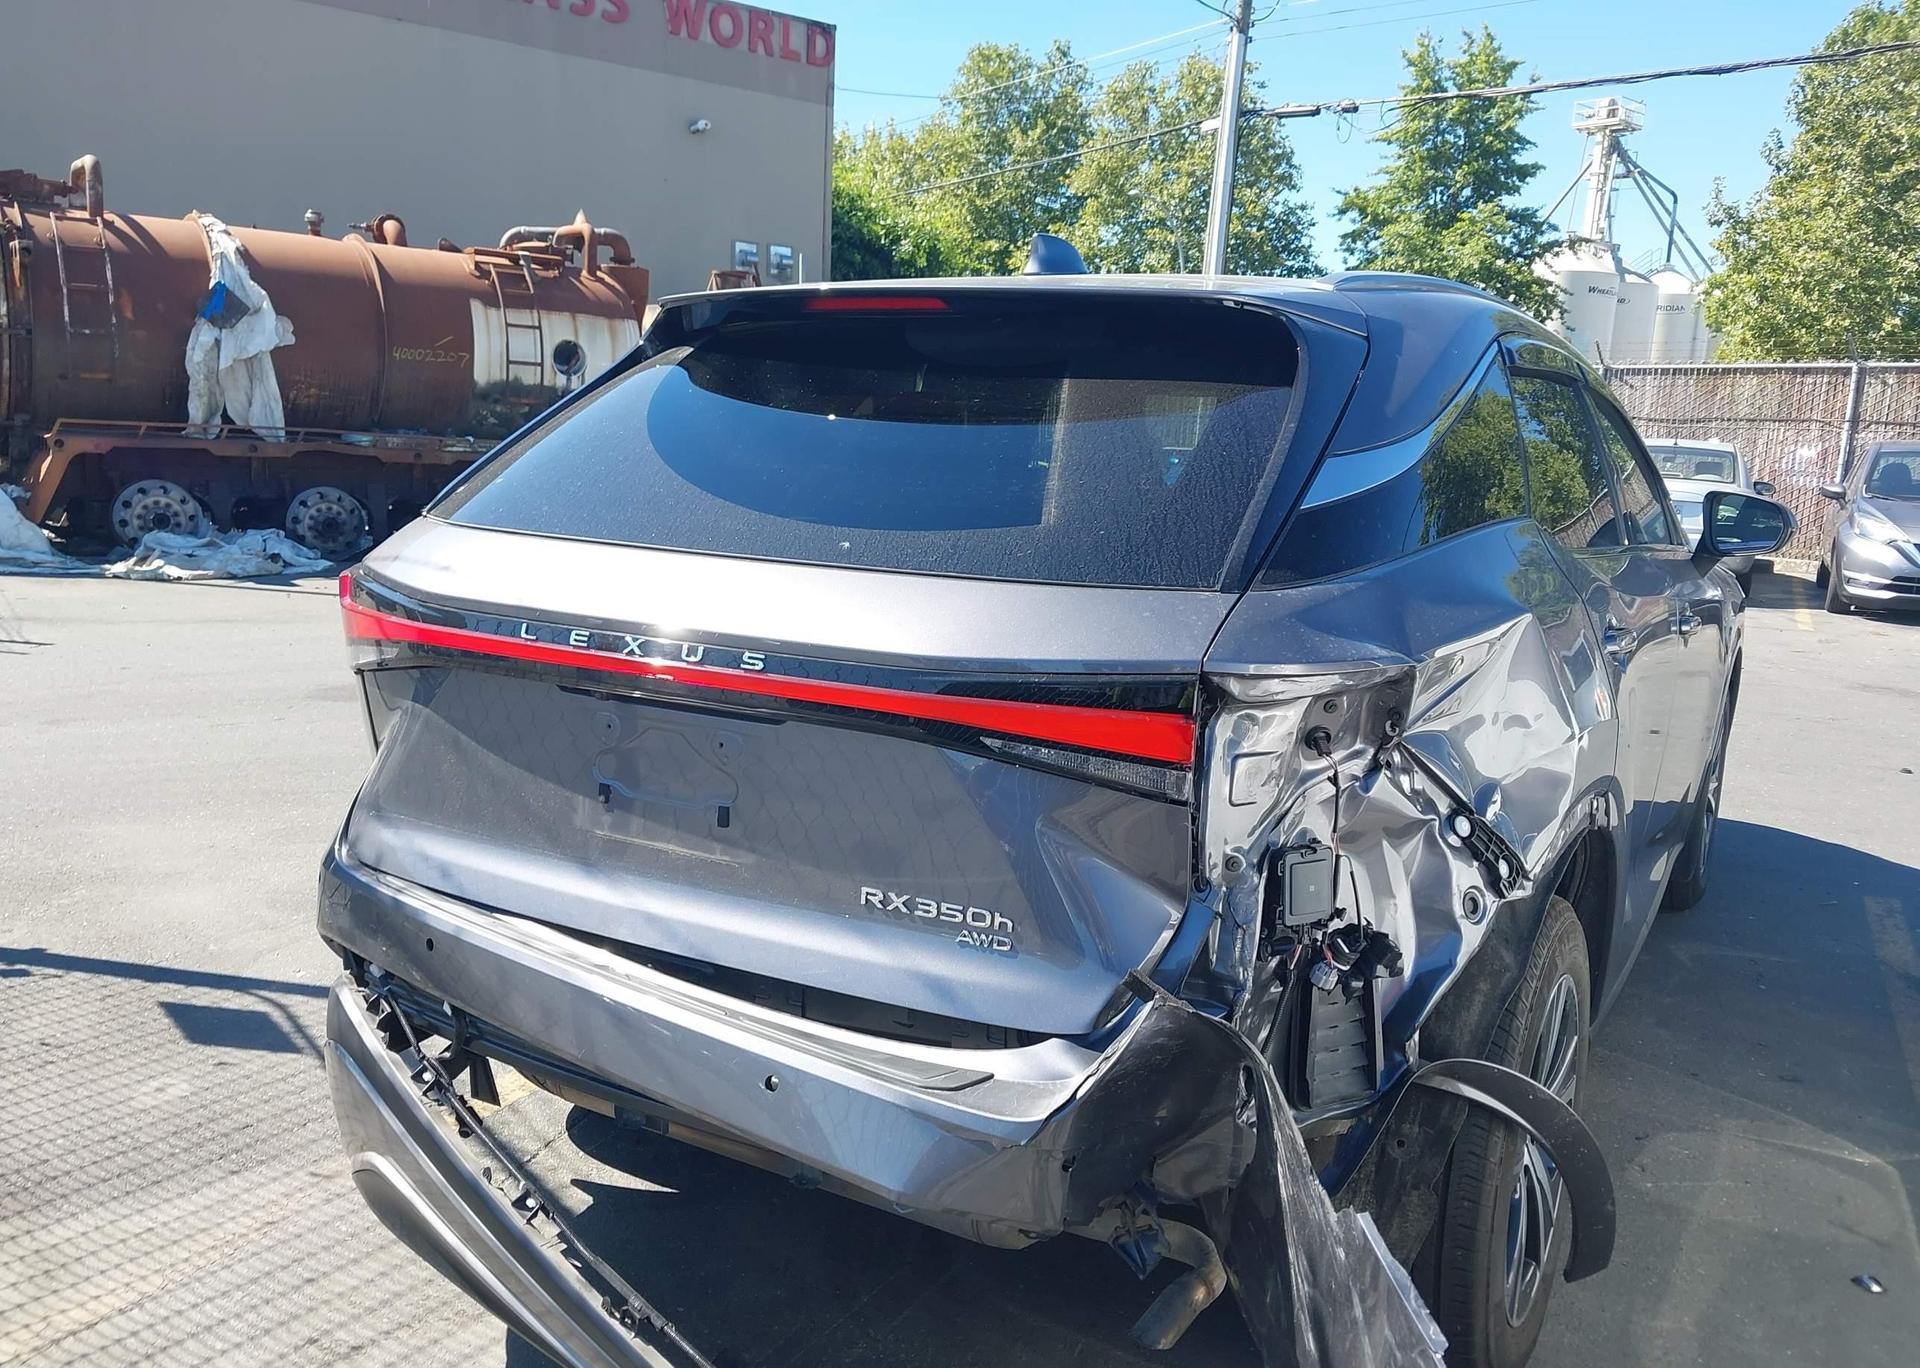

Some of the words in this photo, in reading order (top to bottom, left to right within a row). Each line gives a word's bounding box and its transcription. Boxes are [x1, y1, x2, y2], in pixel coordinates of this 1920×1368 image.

[664, 0, 835, 68] WORLD
[520, 622, 766, 672] LEXUS
[955, 929, 1013, 951] AWD
